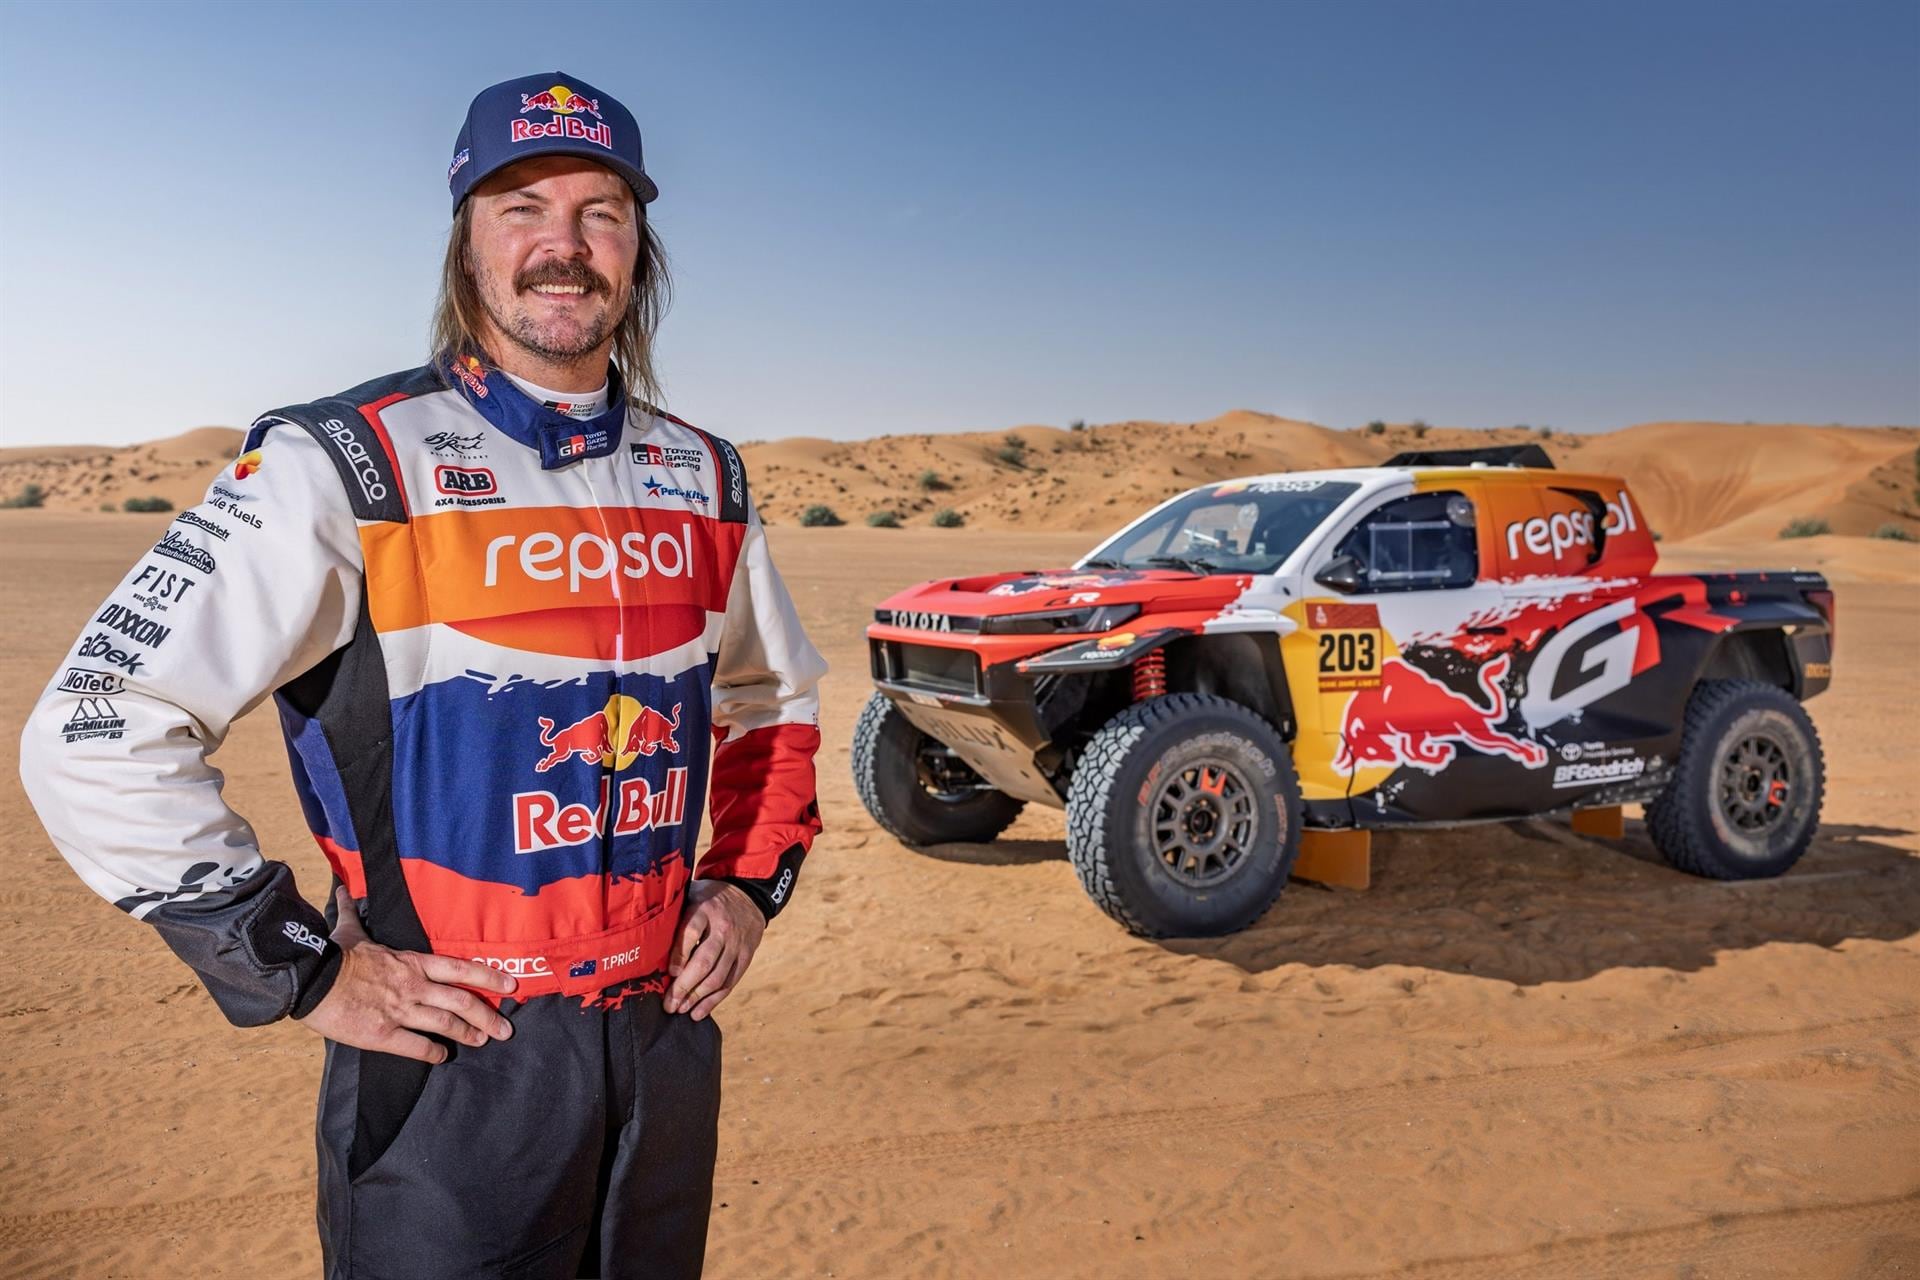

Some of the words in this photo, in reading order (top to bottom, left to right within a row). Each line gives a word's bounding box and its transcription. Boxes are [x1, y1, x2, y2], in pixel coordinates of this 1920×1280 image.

[511, 115, 561, 142] Red
[566, 116, 612, 149] Bull
[422, 431, 486, 444] Black
[434, 439, 483, 454] Rock
[560, 442, 585, 457] GR
[663, 447, 703, 456] TOYOTA
[318, 418, 387, 505] sparco
[633, 452, 663, 465] GR
[665, 454, 701, 463] GAZOO
[666, 460, 700, 472] Racing
[443, 470, 492, 491] ARB
[456, 497, 507, 506] ACCESSORIES
[177, 510, 231, 541] BFGoodrich
[227, 503, 263, 529] fuels
[1506, 489, 1637, 560] repsol
[154, 545, 212, 573] motorbiketours
[485, 523, 694, 593] repsol
[132, 565, 196, 603] FIST
[96, 604, 172, 649] DIXXON
[890, 610, 951, 633] TOYOTA
[1319, 633, 1375, 672] 203
[1553, 757, 1645, 788] BFGoodrich
[513, 775, 611, 854] Red
[613, 766, 688, 837] Bull
[472, 956, 554, 977] parc
[602, 946, 641, 971] T.PRICE
